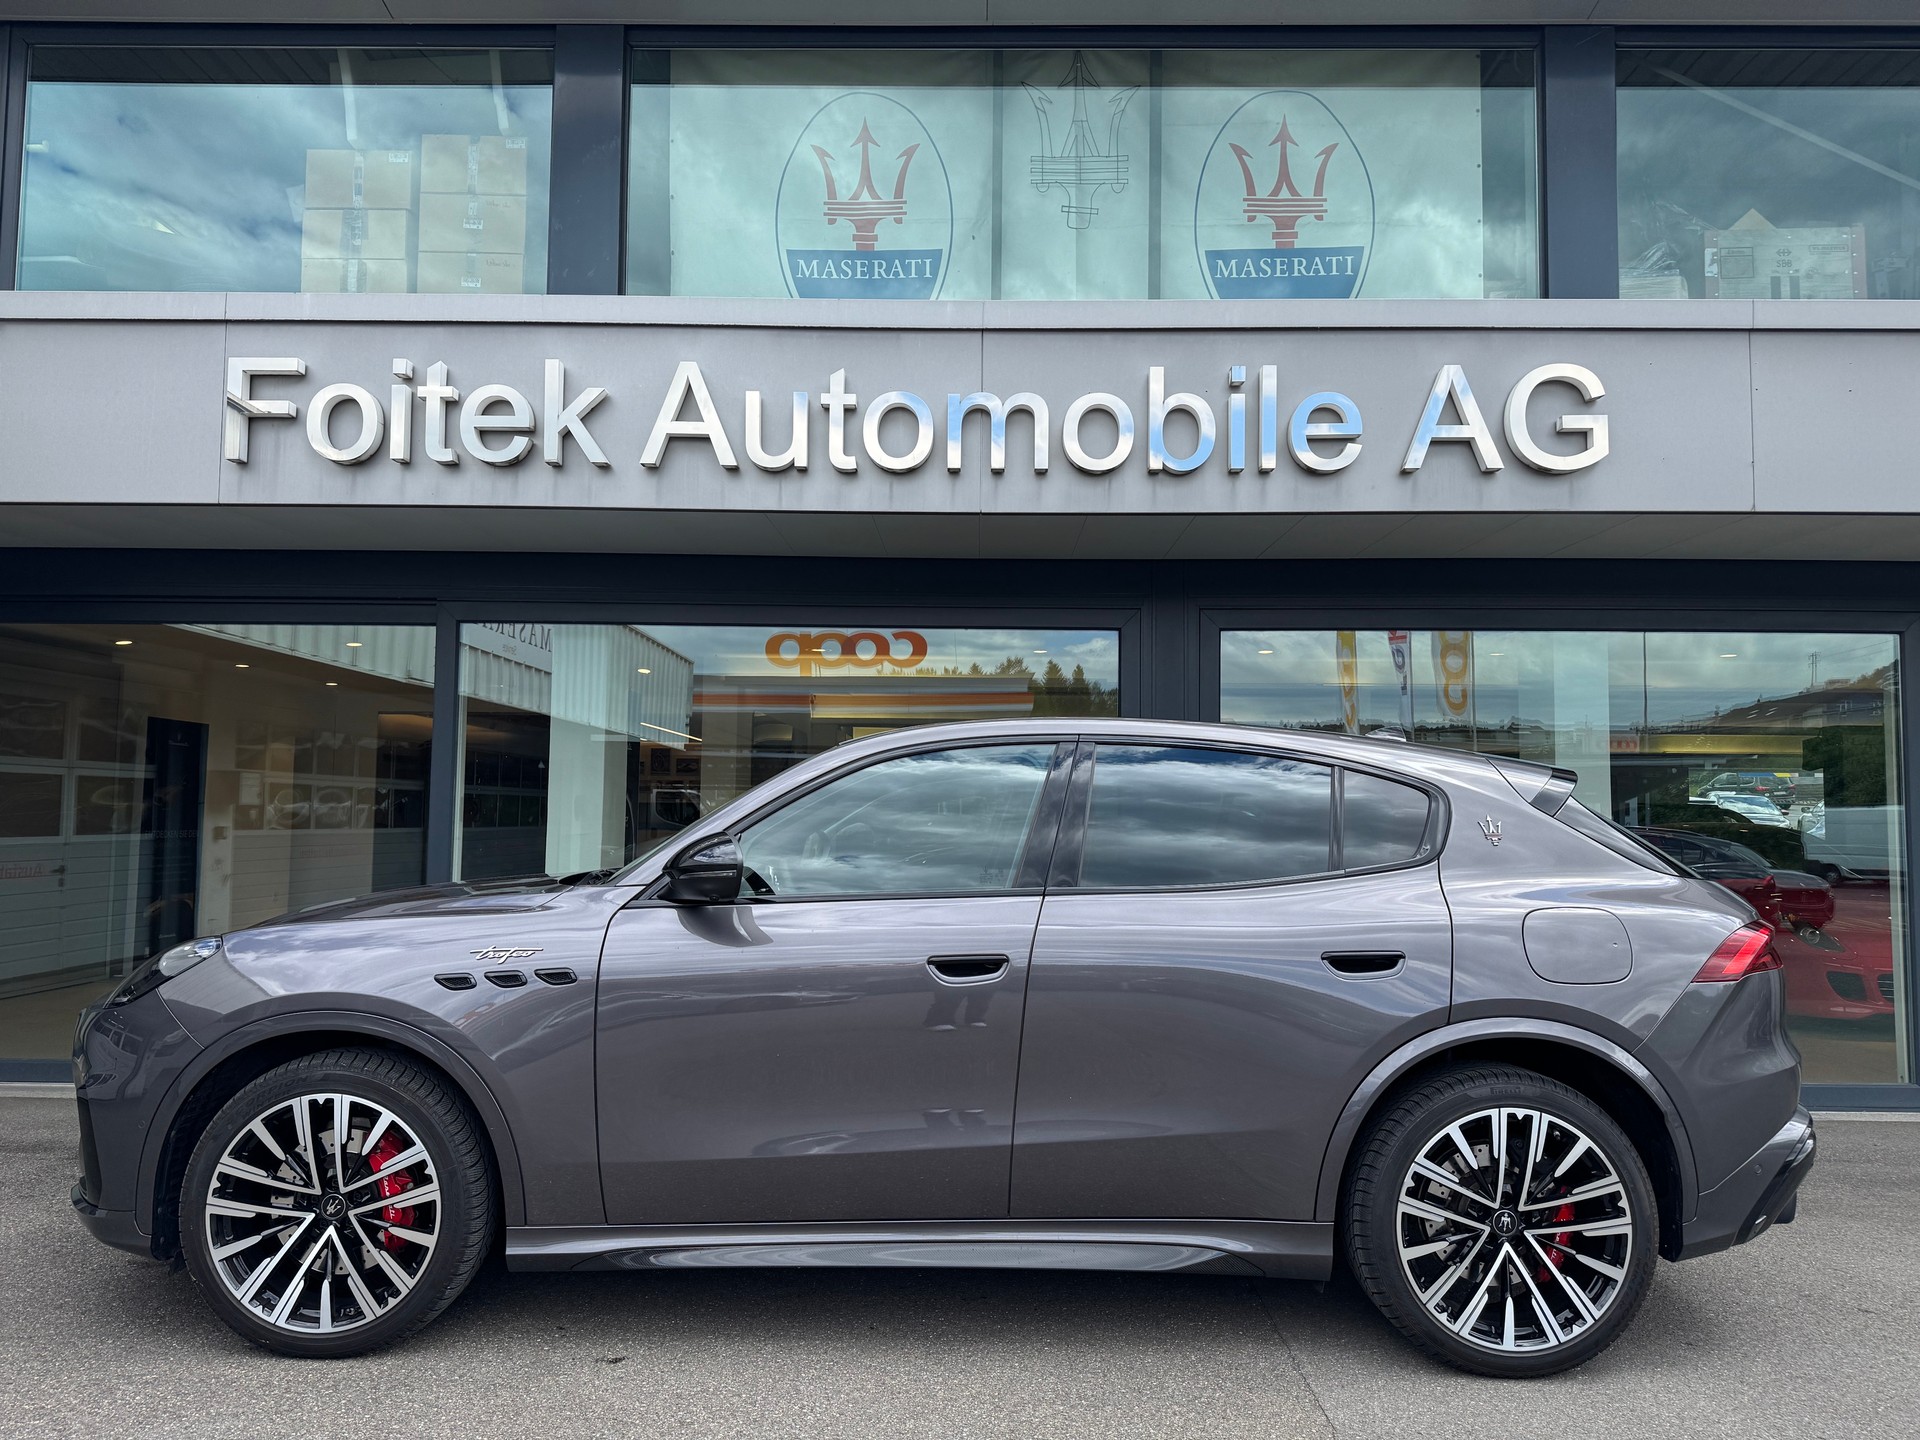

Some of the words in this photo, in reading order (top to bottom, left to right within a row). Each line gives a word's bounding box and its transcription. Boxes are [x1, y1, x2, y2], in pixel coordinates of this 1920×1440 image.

[796, 259, 933, 279] MASERATI
[1215, 255, 1355, 278] MASERATI
[224, 357, 611, 468] Foitek
[639, 361, 1363, 474] Automobile
[1401, 362, 1610, 475] AG
[469, 945, 544, 964] trofeo
